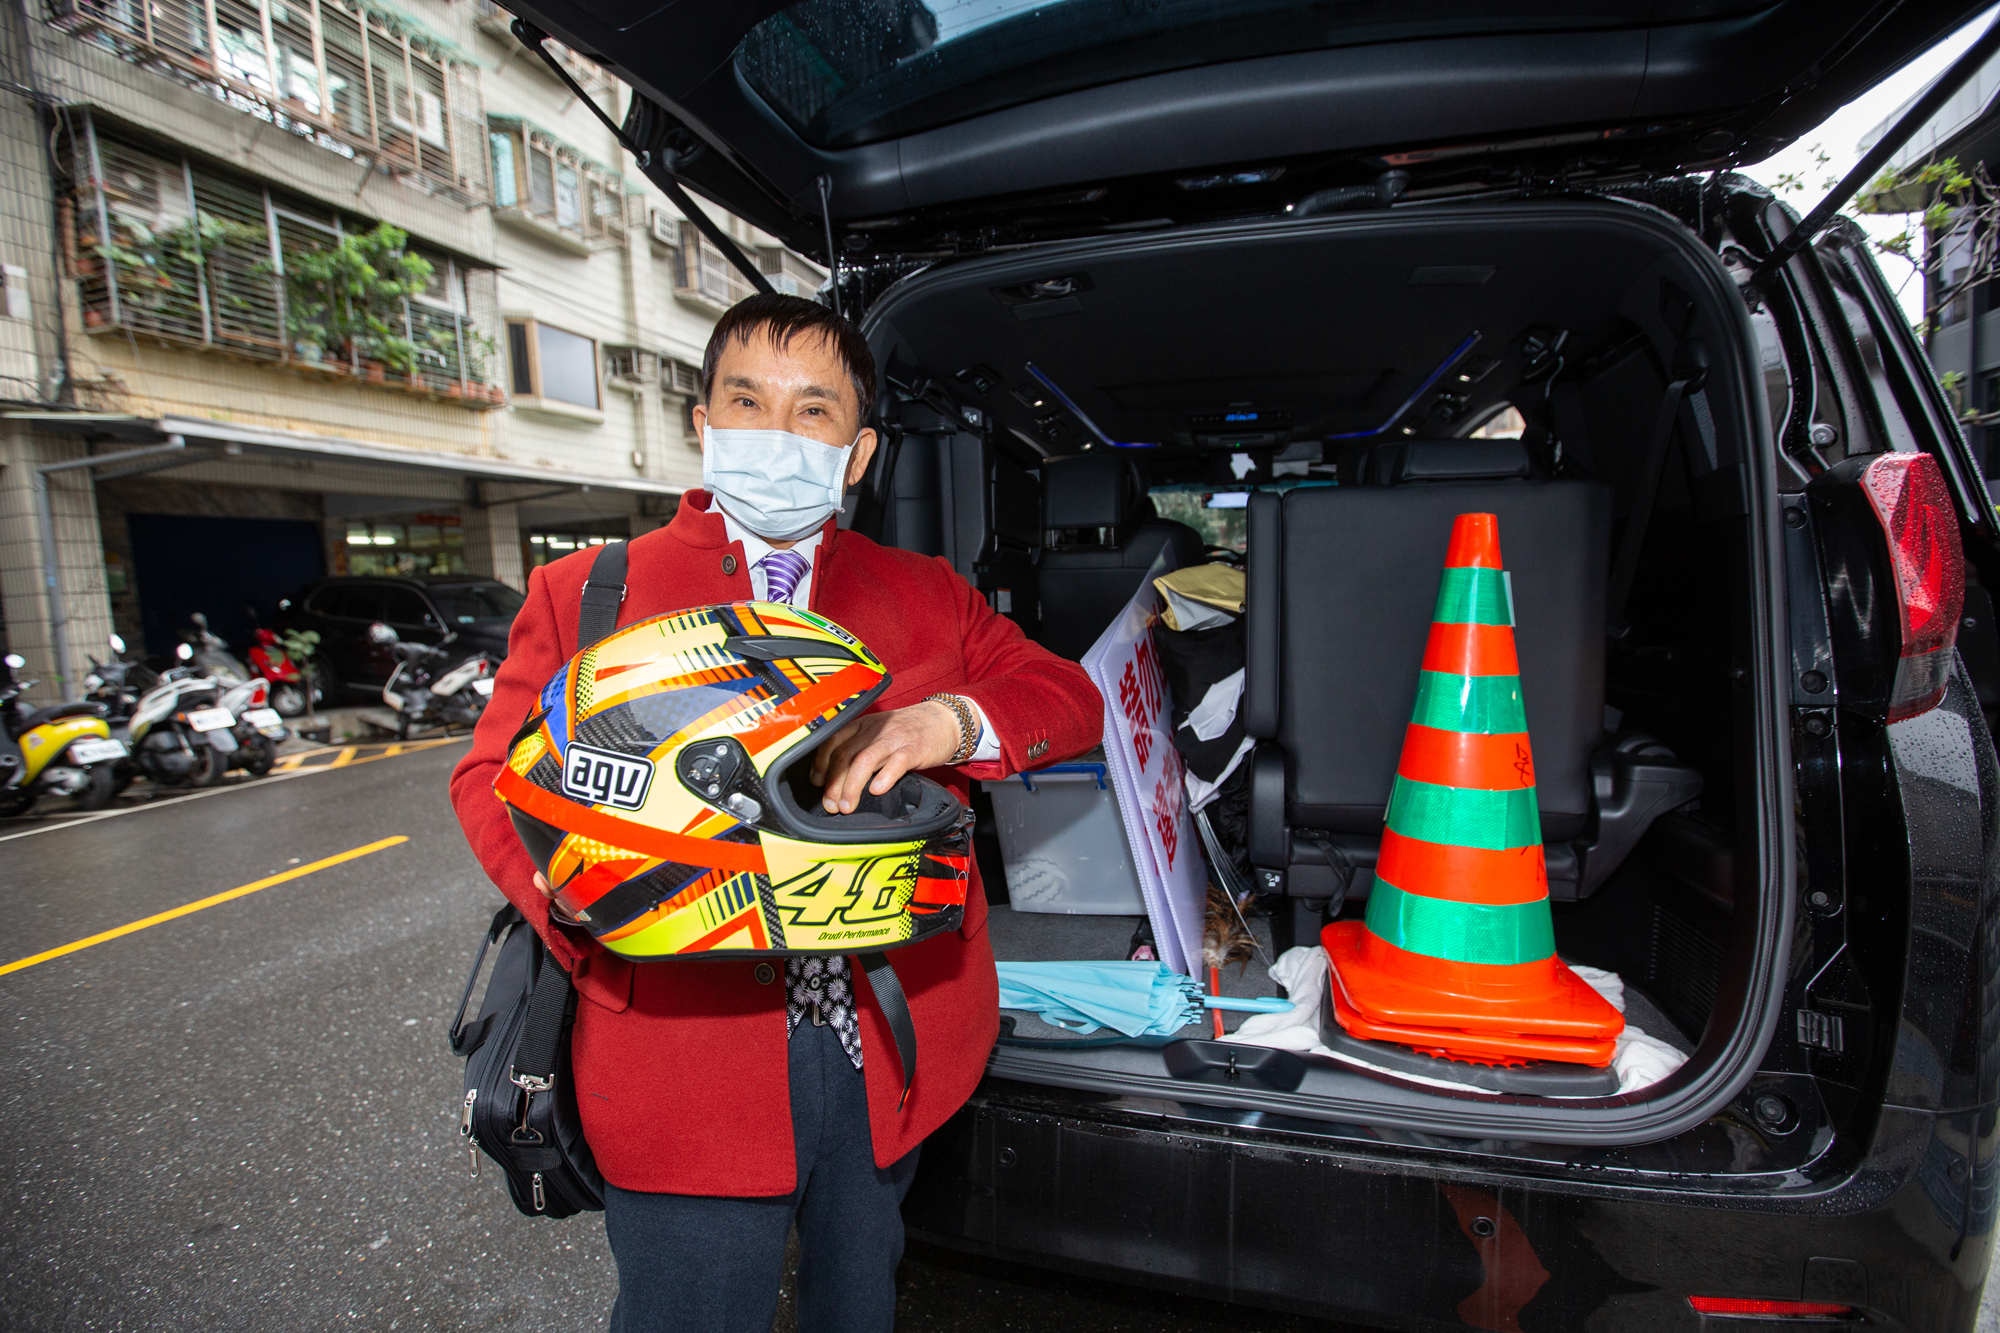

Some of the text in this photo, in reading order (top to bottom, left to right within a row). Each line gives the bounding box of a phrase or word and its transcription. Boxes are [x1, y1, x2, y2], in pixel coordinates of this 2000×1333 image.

[571, 756, 641, 802] agv
[772, 854, 915, 926] 46
[818, 927, 890, 941] Drudi Performance
